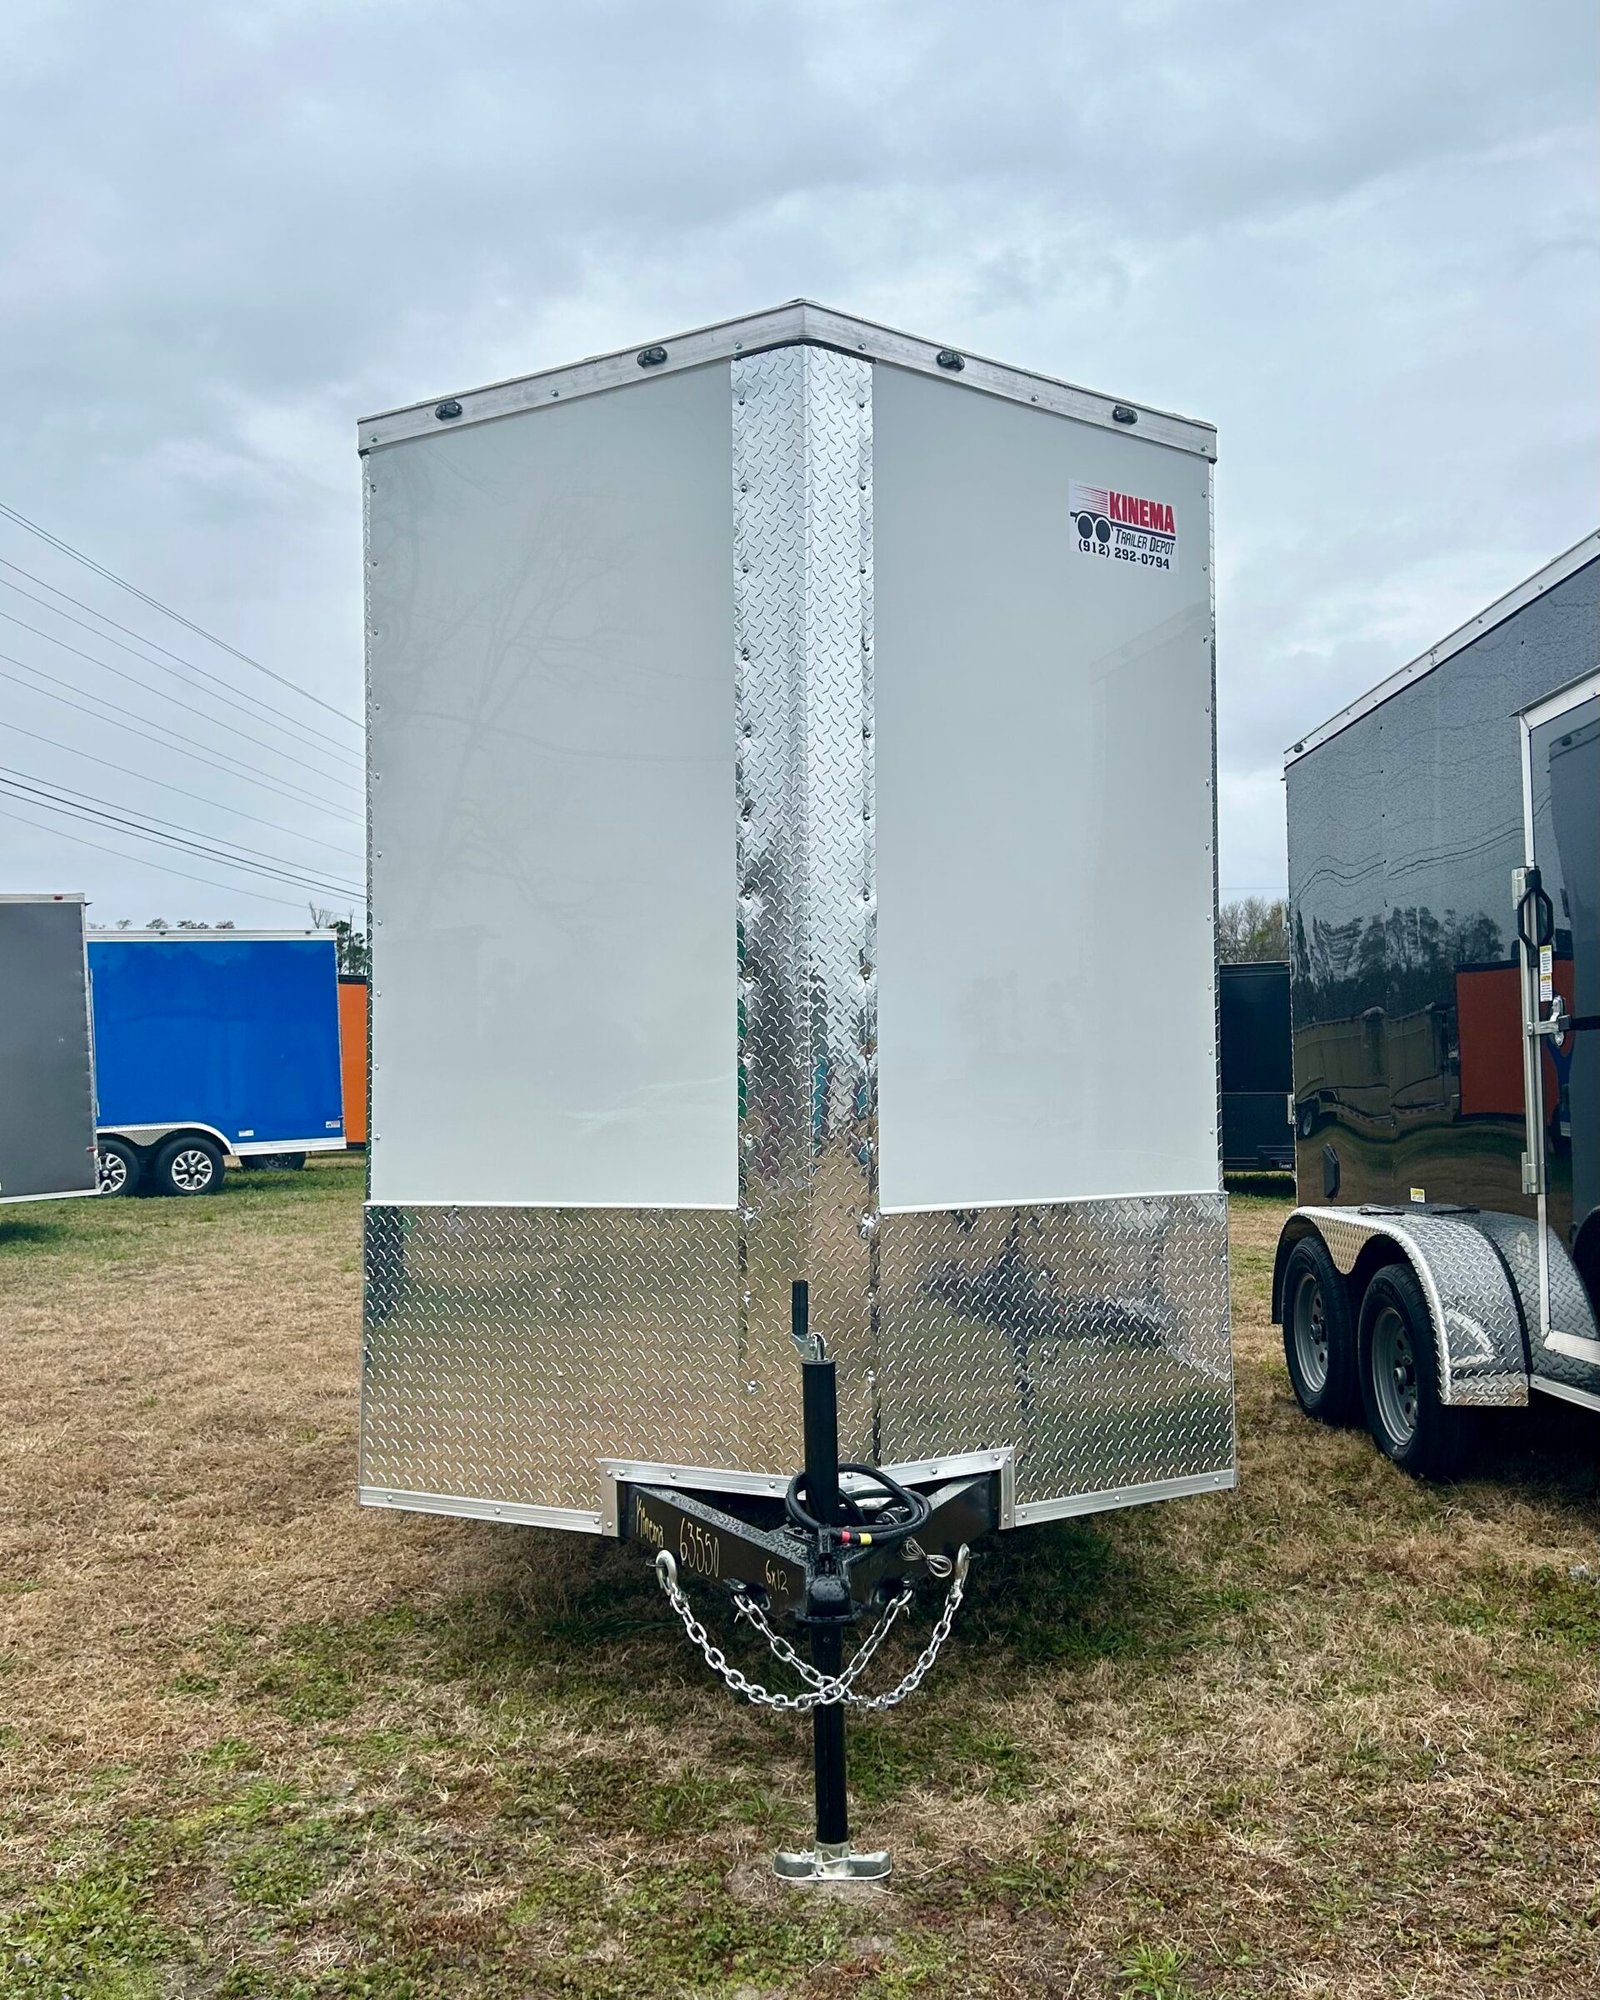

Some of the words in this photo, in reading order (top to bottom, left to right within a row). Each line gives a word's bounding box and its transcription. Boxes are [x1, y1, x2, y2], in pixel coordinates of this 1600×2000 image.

[1109, 490, 1176, 534] KINEMA
[1078, 538, 1110, 558] (912)
[1114, 547, 1170, 570] 292-0794
[1115, 528, 1148, 549] TRAILER
[1149, 536, 1175, 556] DEPOT
[679, 1517, 720, 1579] 63550
